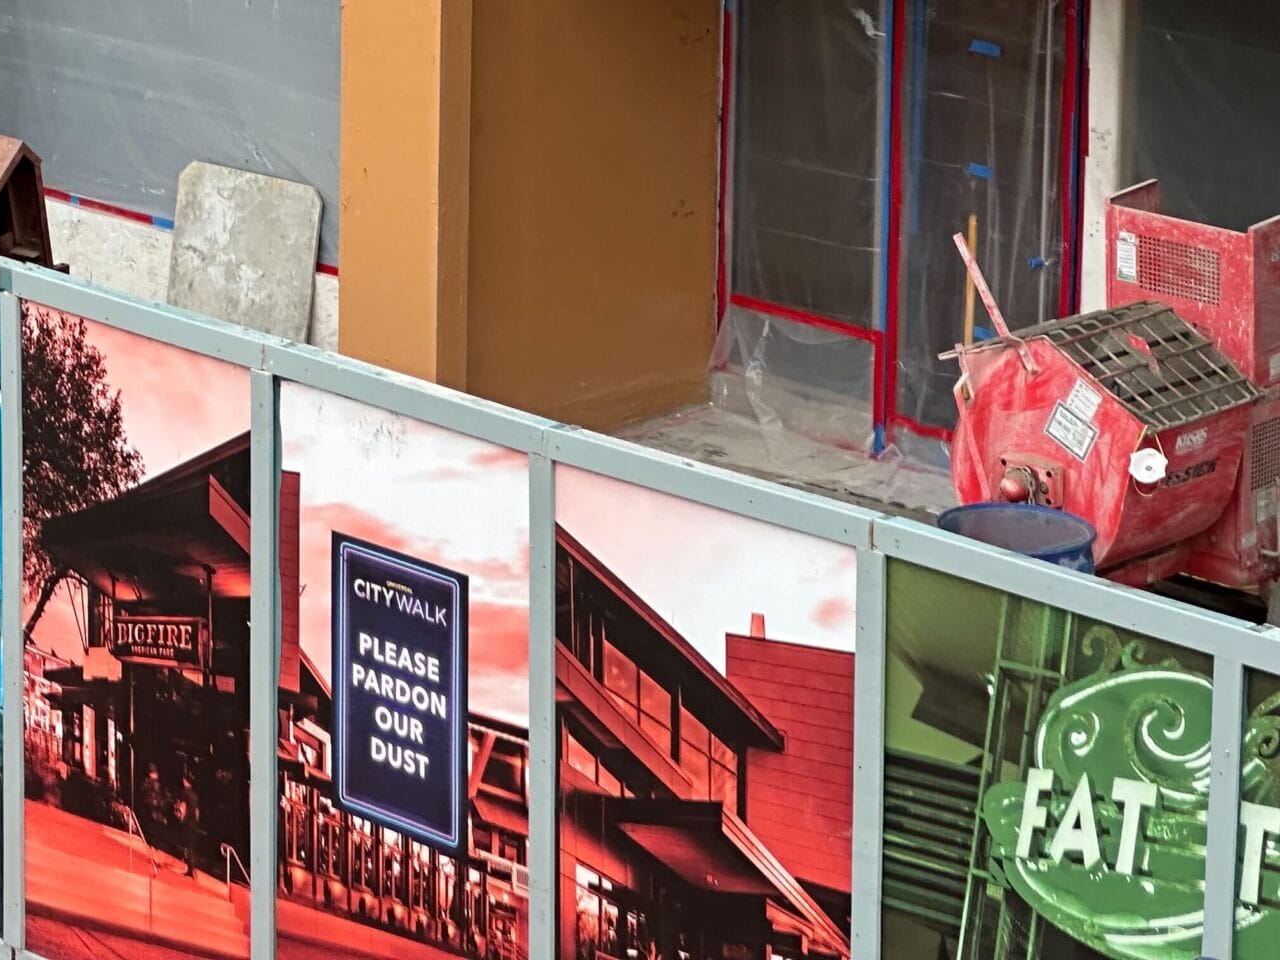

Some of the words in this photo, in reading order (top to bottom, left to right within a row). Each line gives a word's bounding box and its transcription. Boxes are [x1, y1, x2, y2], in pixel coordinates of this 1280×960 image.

[354, 578, 447, 628] CITYWALK
[117, 623, 192, 650] BIGFIRE
[359, 632, 440, 682] PLEASE
[352, 663, 447, 719] PARDON
[374, 706, 424, 745] OUR
[370, 736, 429, 779] DUST
[1016, 767, 1157, 876] FAT
